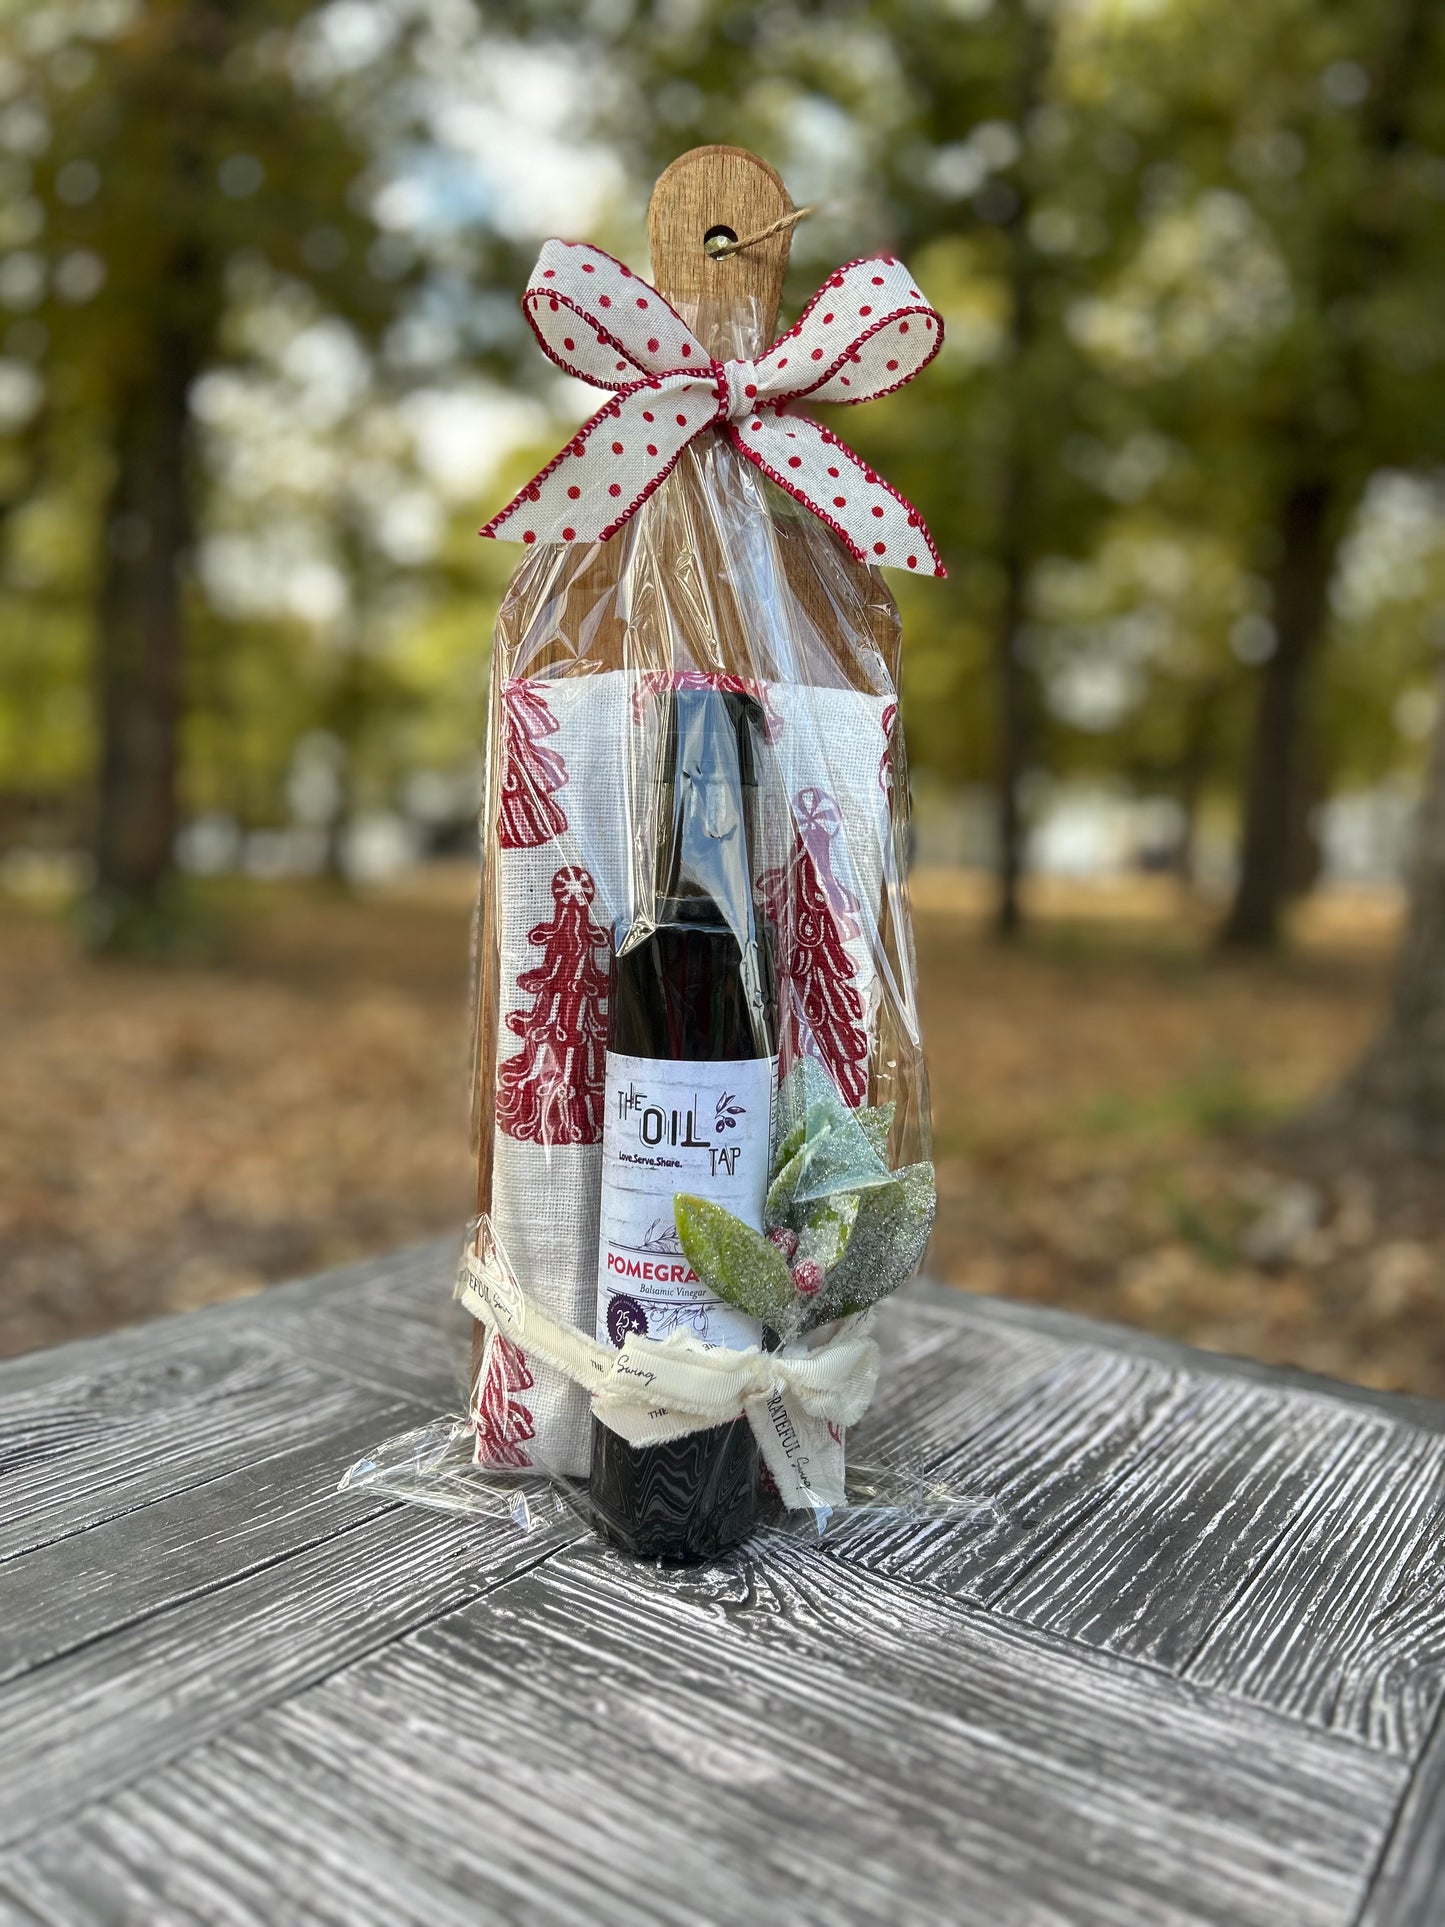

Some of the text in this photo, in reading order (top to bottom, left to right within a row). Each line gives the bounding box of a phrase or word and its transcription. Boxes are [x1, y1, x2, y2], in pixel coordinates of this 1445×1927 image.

[618, 1082, 648, 1120] THE
[639, 1093, 711, 1149] OIL
[708, 1145, 741, 1177] TAP
[607, 1252, 701, 1283] POMEGRA
[639, 1283, 708, 1300] Balsamic Vinegar
[615, 1309, 630, 1329] 25
[590, 1359, 605, 1373] THE
[616, 1354, 657, 1387] Swing
[647, 1406, 669, 1420] THE
